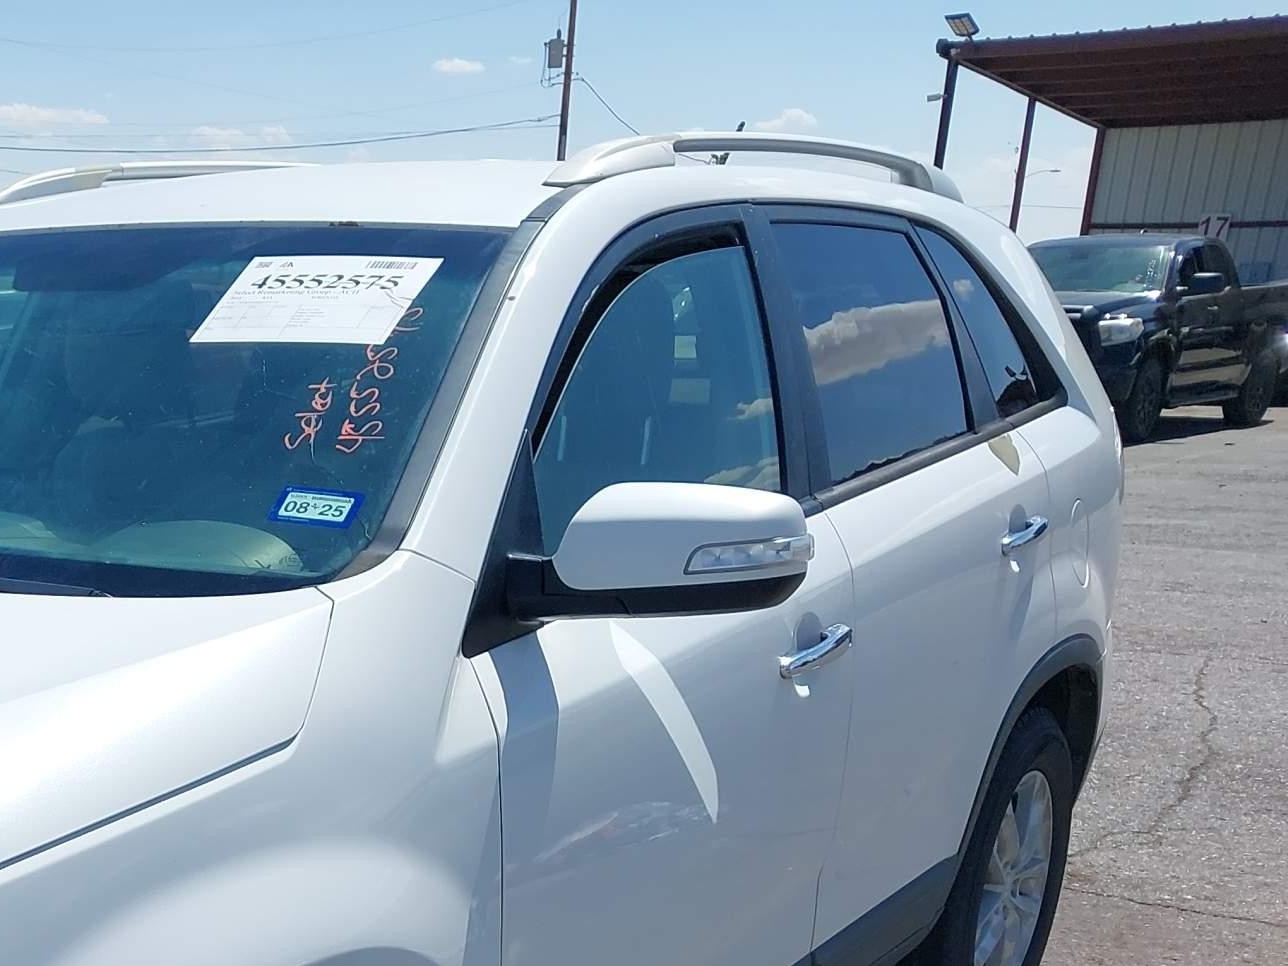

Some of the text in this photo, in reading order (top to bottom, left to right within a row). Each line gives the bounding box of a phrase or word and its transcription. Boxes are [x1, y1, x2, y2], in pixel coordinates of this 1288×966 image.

[1200, 216, 1230, 237] 17
[251, 273, 404, 290] 45552575
[283, 500, 347, 518] 08 25
